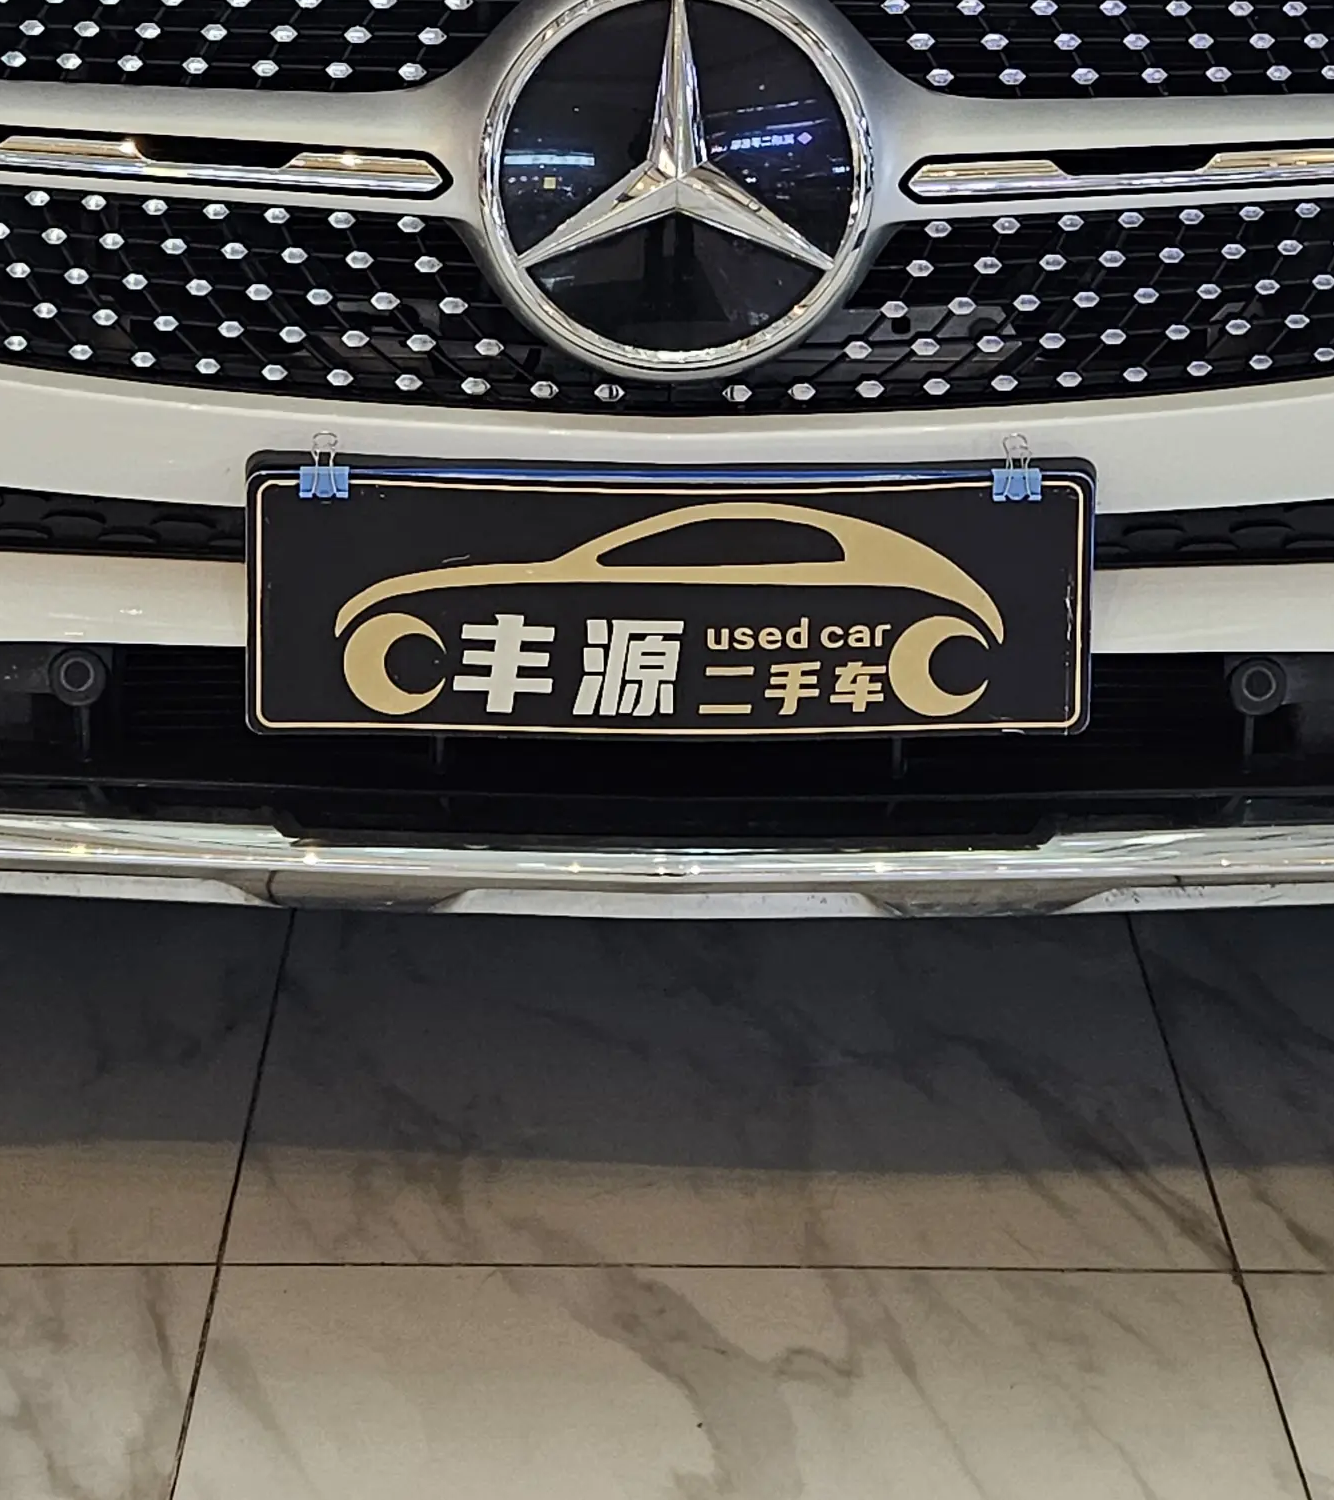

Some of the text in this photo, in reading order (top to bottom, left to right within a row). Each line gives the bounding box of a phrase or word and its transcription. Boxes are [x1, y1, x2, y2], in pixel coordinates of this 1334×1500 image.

[708, 618, 891, 649] used car
[453, 614, 684, 716] 丰源
[699, 661, 886, 714] 二手车
